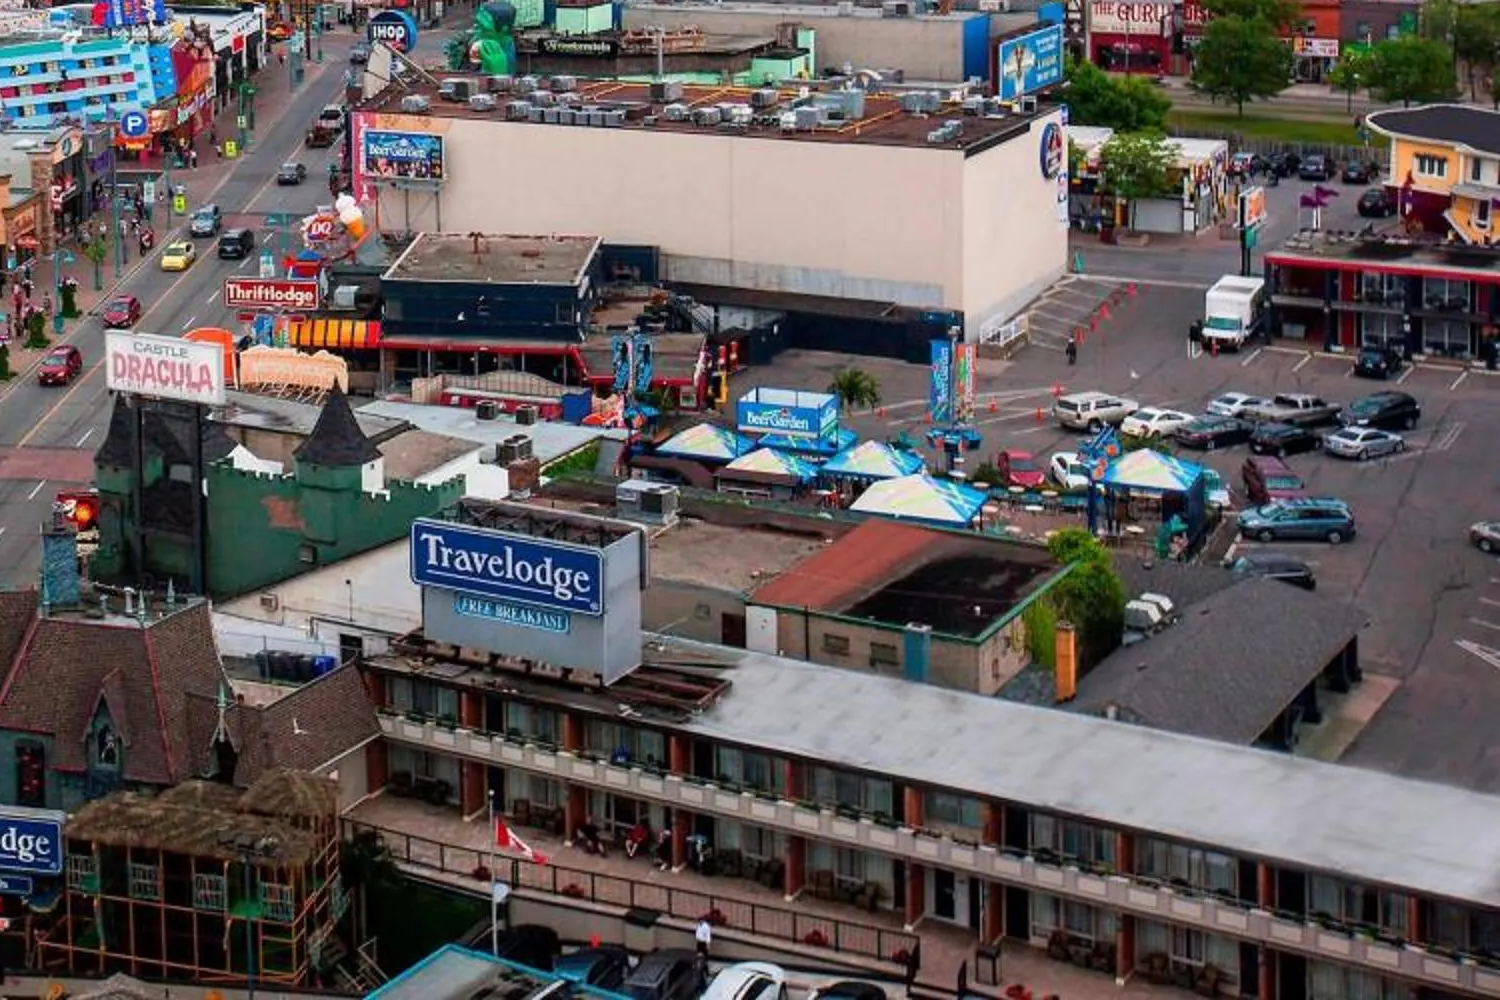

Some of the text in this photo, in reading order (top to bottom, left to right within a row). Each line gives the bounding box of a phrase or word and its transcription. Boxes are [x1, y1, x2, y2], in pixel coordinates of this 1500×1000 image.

[1118, 2, 1169, 23] GURU
[373, 25, 405, 42] IHOP
[127, 115, 143, 132] P
[311, 220, 332, 234] DQ
[227, 284, 313, 307] Thriftlodge
[133, 341, 189, 358] CASTLE
[112, 350, 215, 394] DRACULA
[420, 533, 591, 600] Travelodge
[461, 599, 564, 629] FREE BREAKFAST
